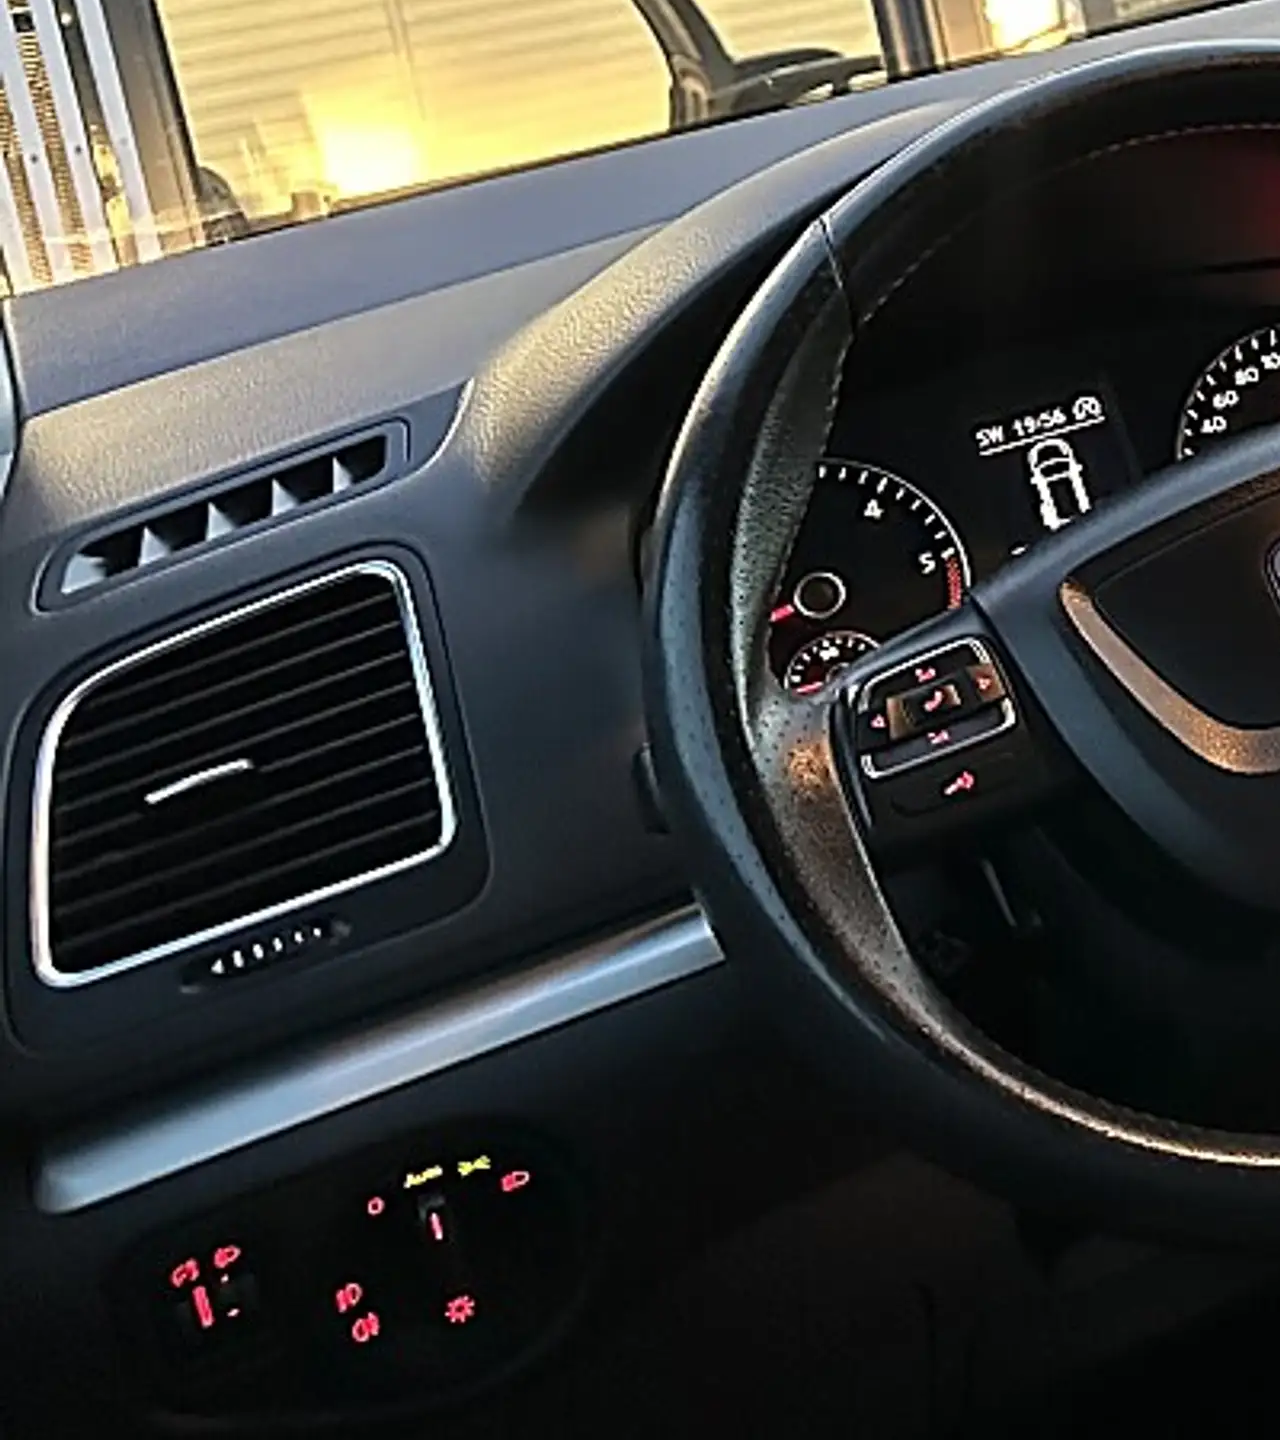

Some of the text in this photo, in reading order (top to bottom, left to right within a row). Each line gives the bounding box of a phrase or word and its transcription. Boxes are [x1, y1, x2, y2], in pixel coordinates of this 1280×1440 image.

[1235, 366, 1259, 386] 80
[1213, 390, 1239, 409] 60
[1200, 415, 1226, 433] 40
[864, 499, 884, 520] 4
[918, 552, 936, 575] 5
